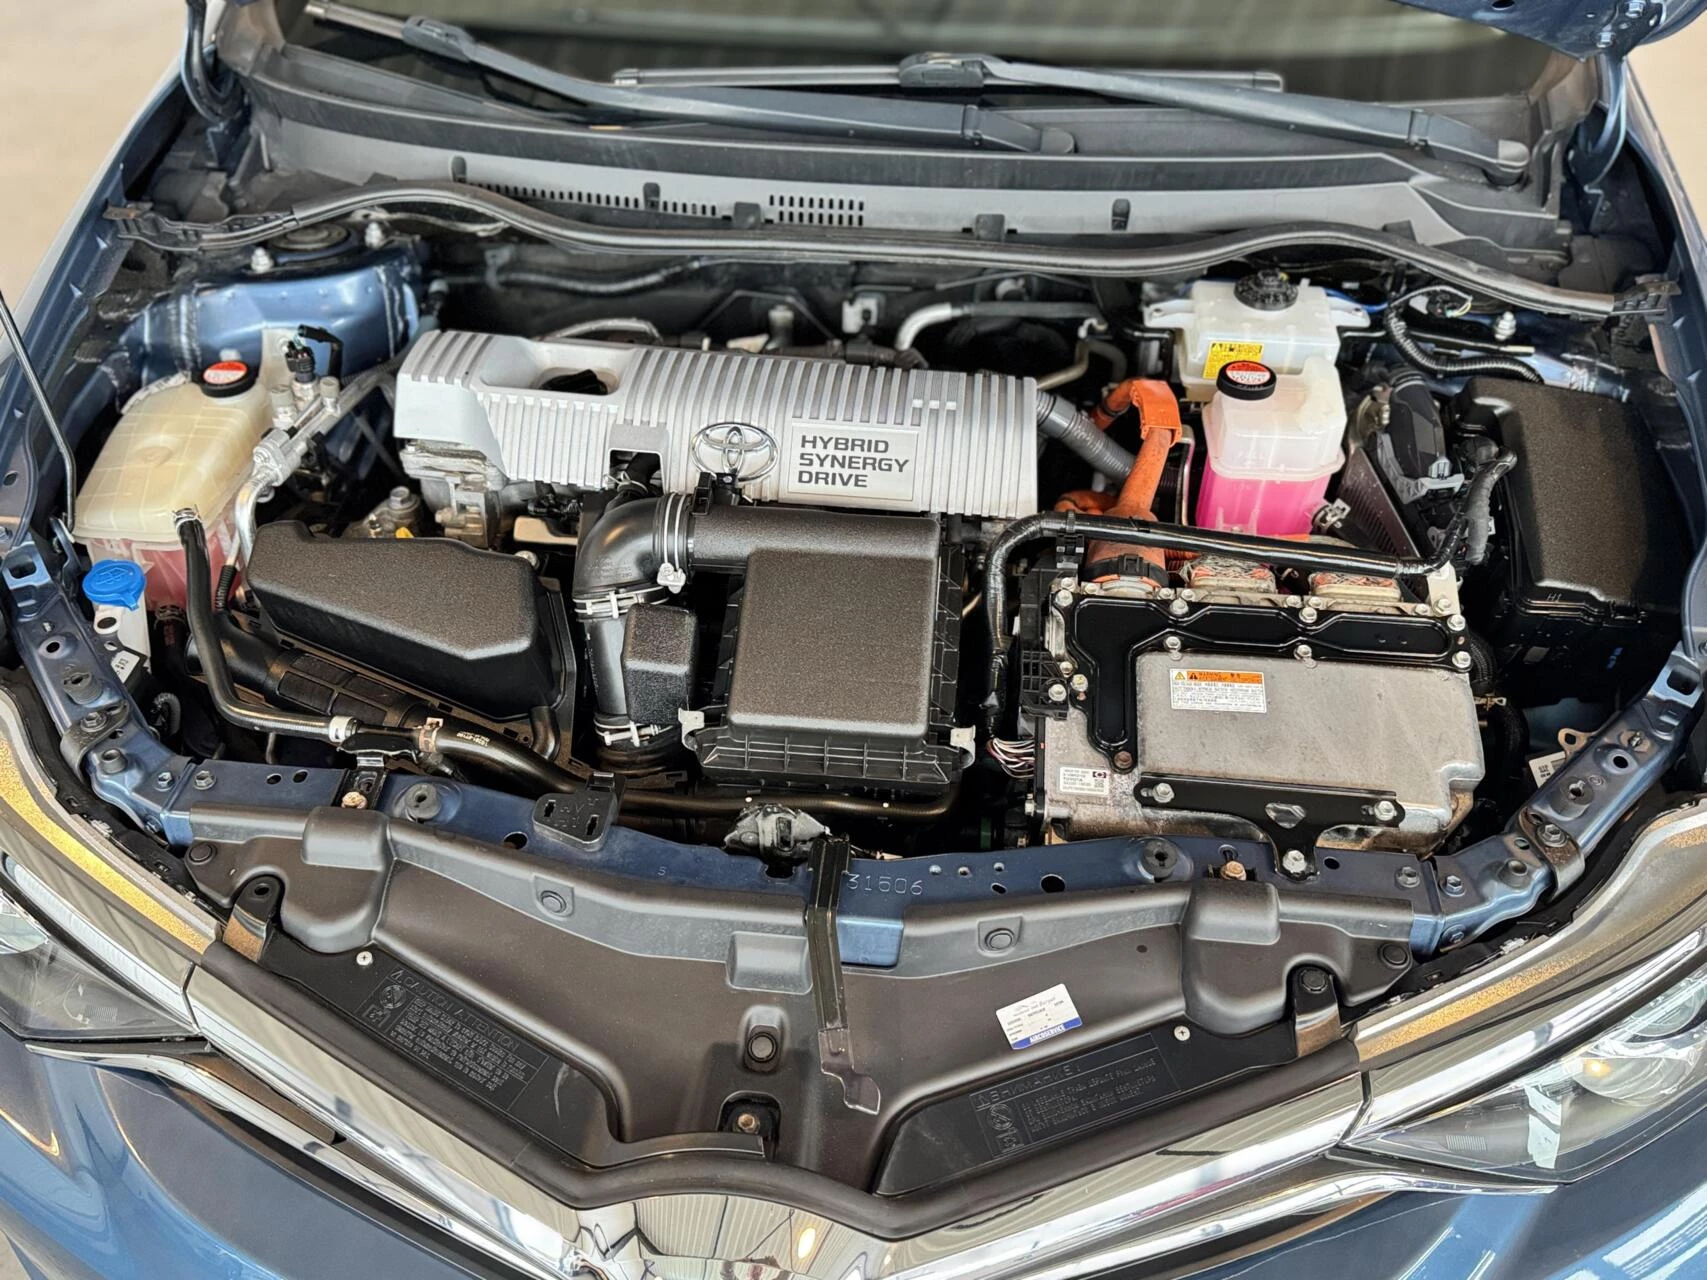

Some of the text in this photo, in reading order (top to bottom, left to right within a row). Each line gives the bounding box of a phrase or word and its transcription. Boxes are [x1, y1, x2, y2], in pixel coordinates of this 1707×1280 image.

[801, 435, 889, 453] HYBRID
[799, 452, 910, 473] SYNERGY
[797, 470, 869, 488] DRIVE
[403, 976, 455, 1011] CAUTION
[453, 1008, 520, 1052] ATTENTION
